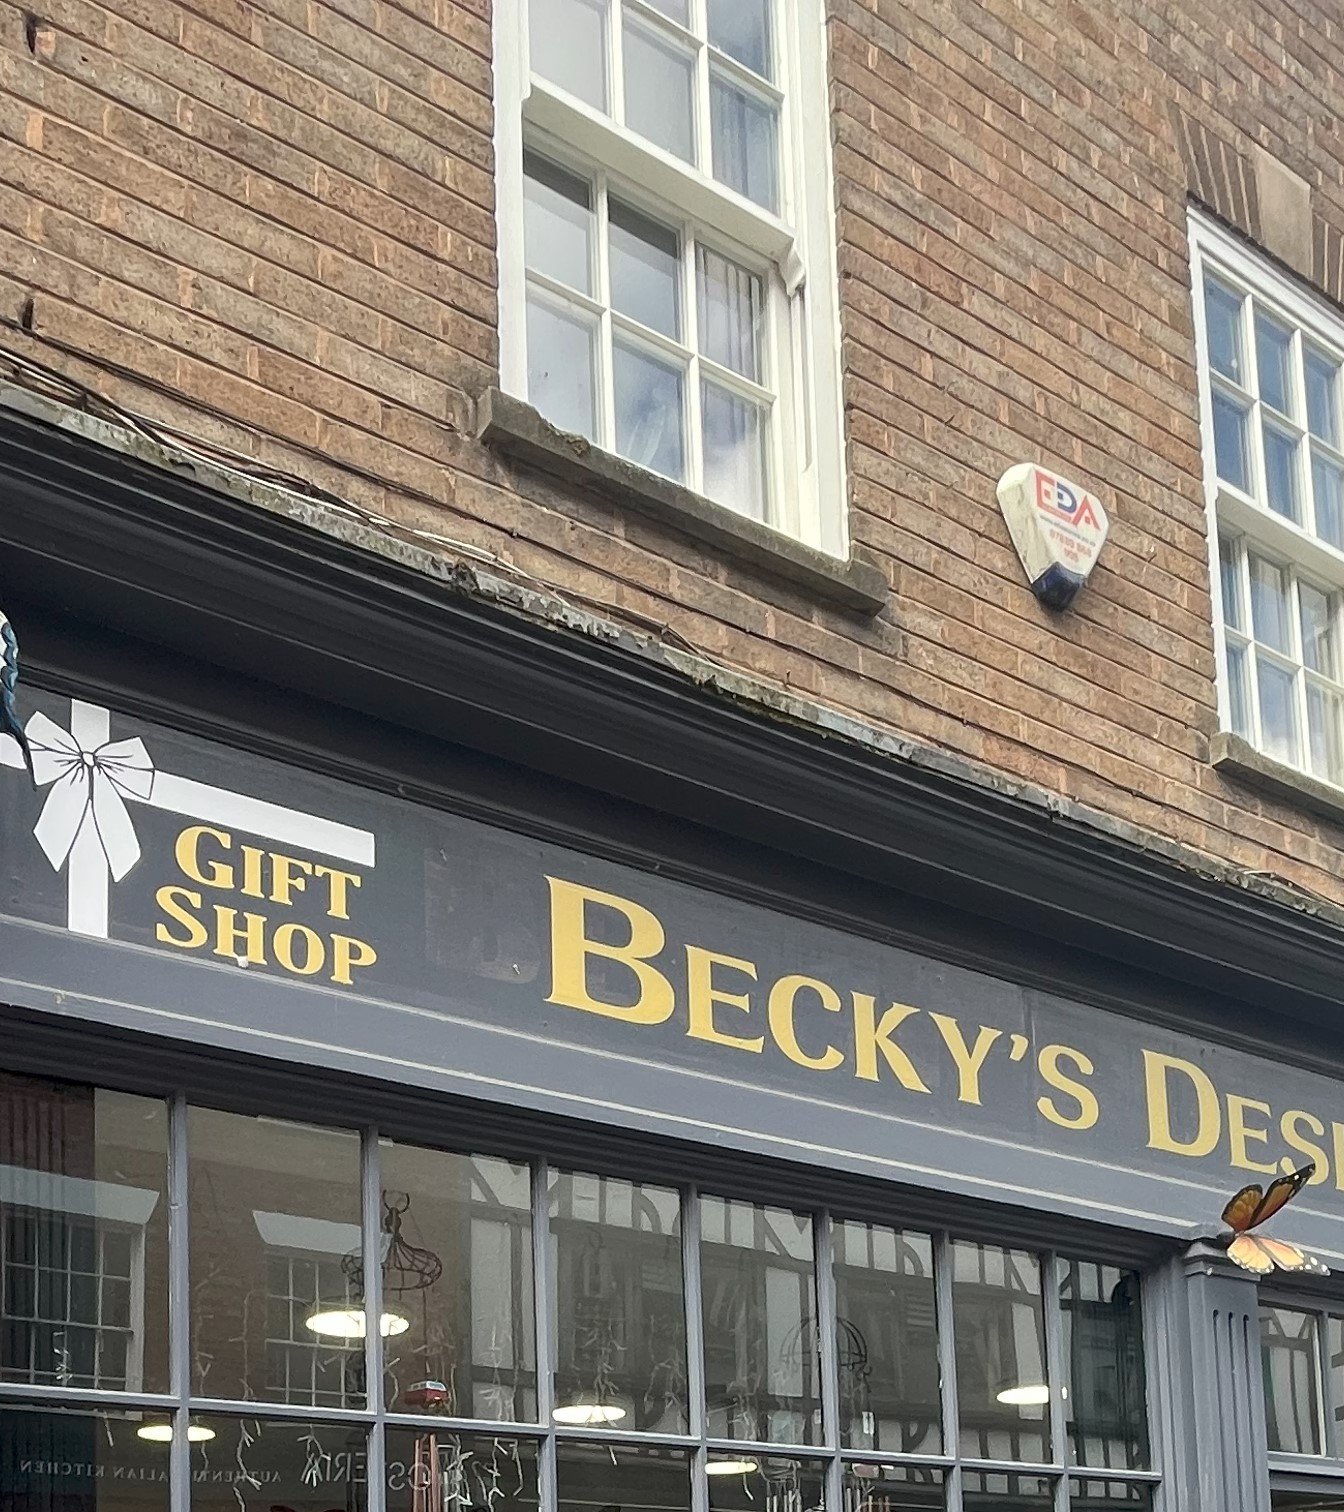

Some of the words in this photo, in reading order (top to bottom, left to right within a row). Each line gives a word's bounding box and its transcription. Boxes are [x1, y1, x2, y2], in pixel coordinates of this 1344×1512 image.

[1034, 469, 1101, 531] EDA
[174, 825, 362, 921] GIFT
[155, 885, 378, 985] SHOP
[544, 875, 1100, 1131] BECKY'S
